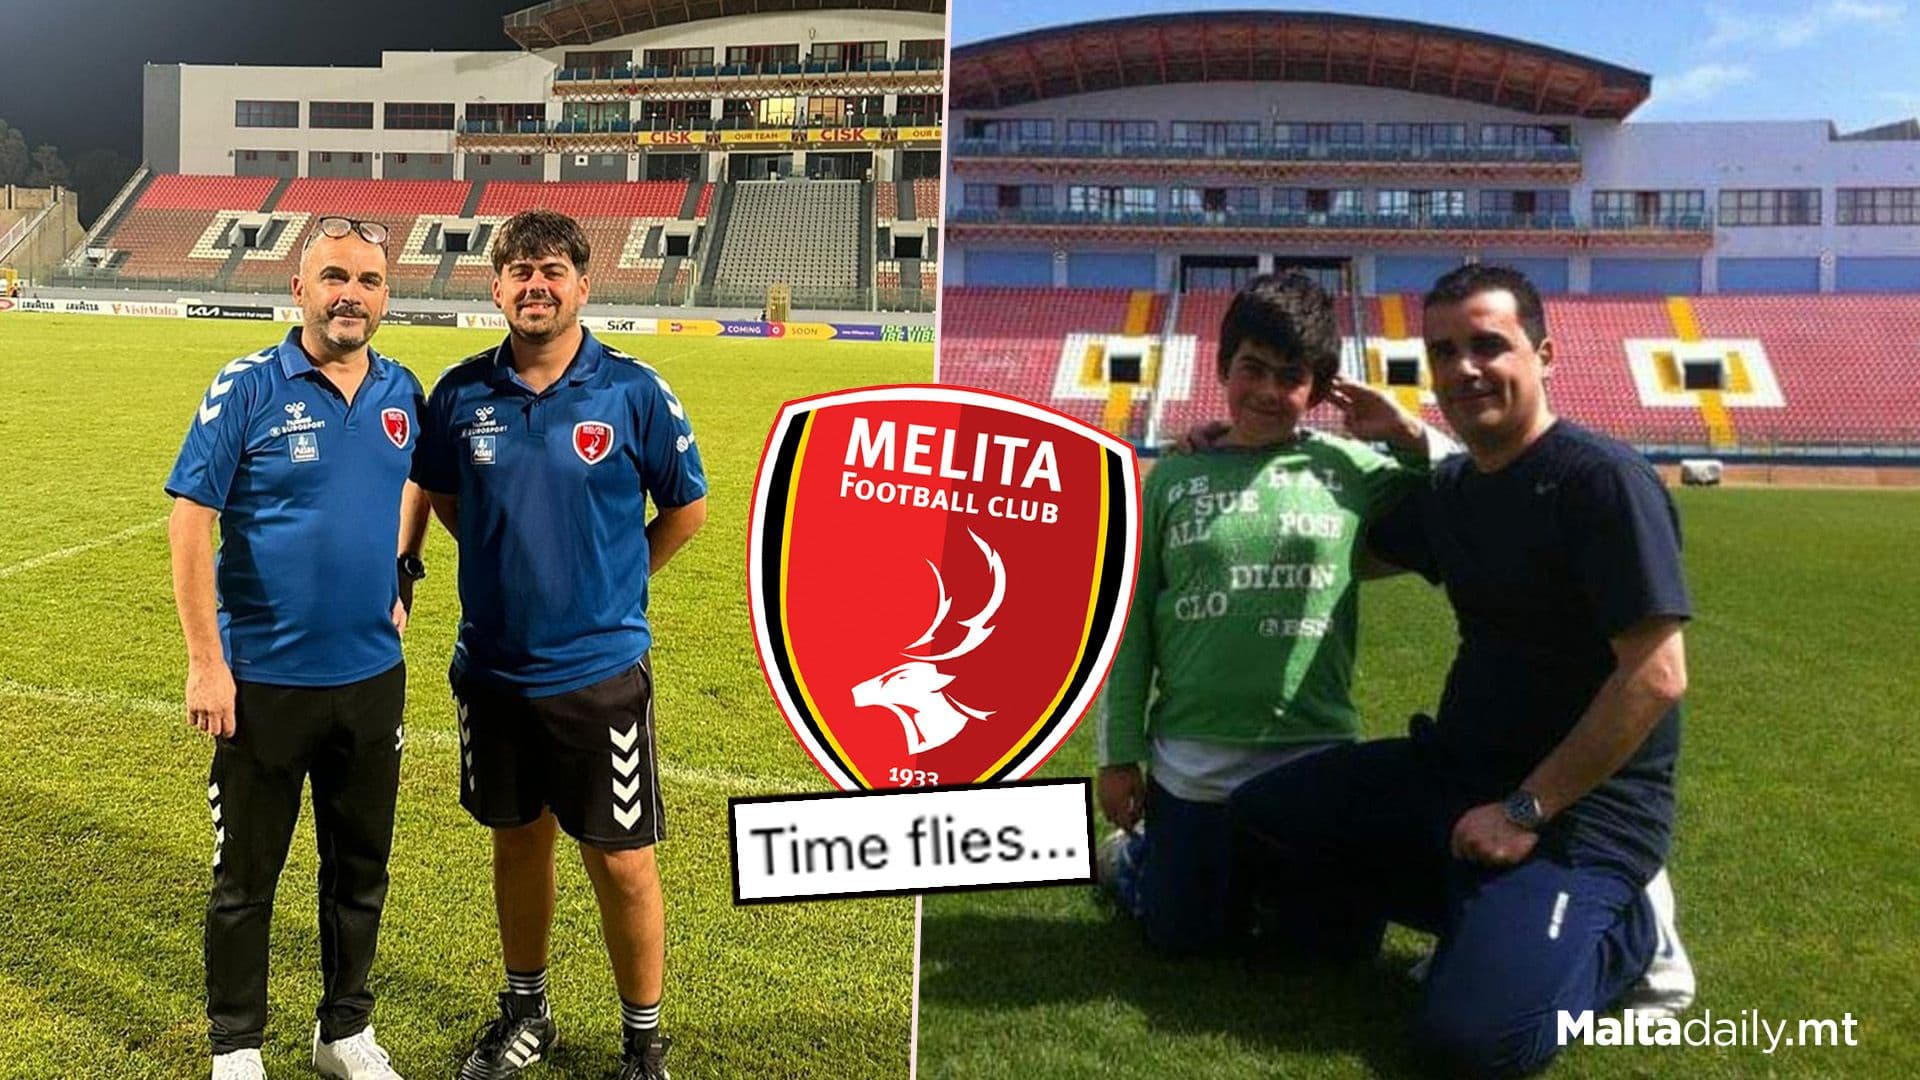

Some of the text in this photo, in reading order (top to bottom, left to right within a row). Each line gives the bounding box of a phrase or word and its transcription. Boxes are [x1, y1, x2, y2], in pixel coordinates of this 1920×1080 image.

[650, 130, 691, 144] CISK
[734, 132, 778, 141] OUR TEAM
[820, 128, 865, 141] CISK
[912, 130, 932, 138] OUR
[727, 325, 818, 336] COMING SOON
[1194, 489, 1259, 516] SUE
[1169, 519, 1211, 548] ALL
[1280, 511, 1344, 539] POSE
[1230, 563, 1337, 590] DITION
[1174, 591, 1228, 621] CLO
